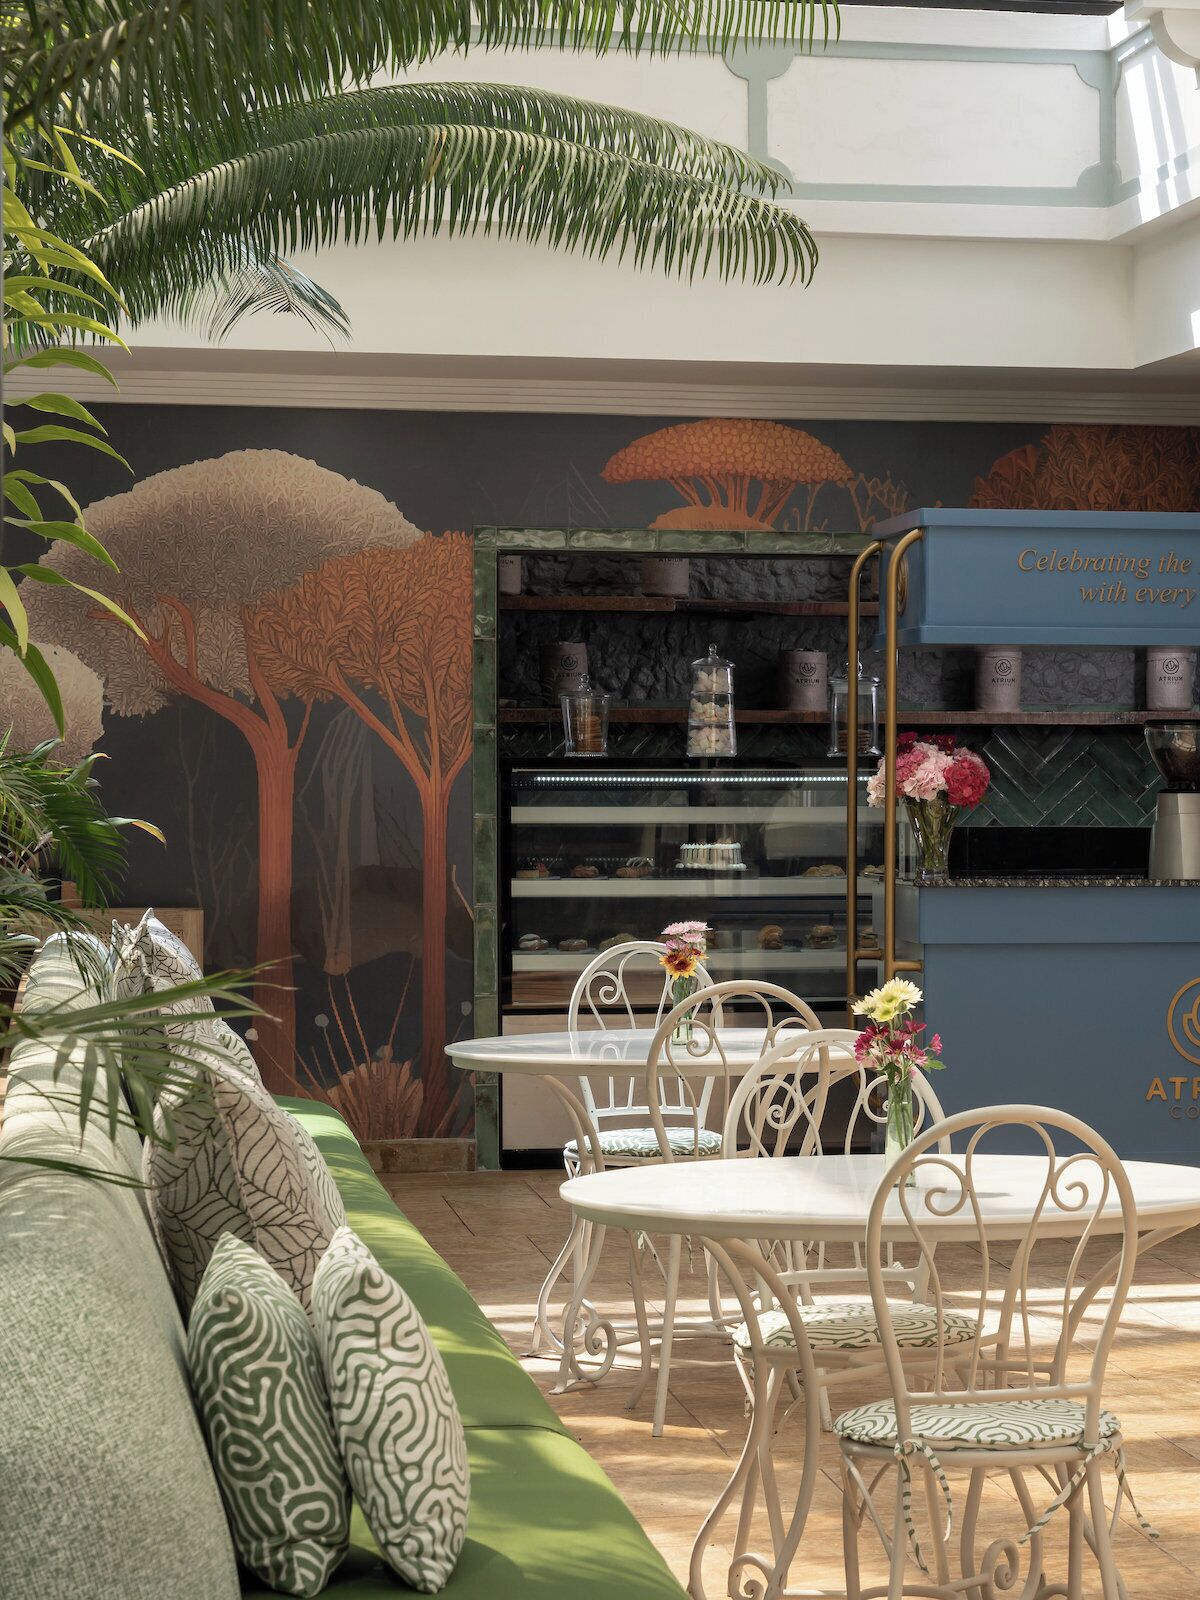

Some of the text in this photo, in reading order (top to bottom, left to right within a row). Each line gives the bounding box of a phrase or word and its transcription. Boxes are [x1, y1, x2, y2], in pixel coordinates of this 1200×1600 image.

[1017, 549, 1151, 578] Celebrating
[1158, 551, 1192, 573] the
[1080, 581, 1128, 602] with
[1135, 586, 1197, 609] every
